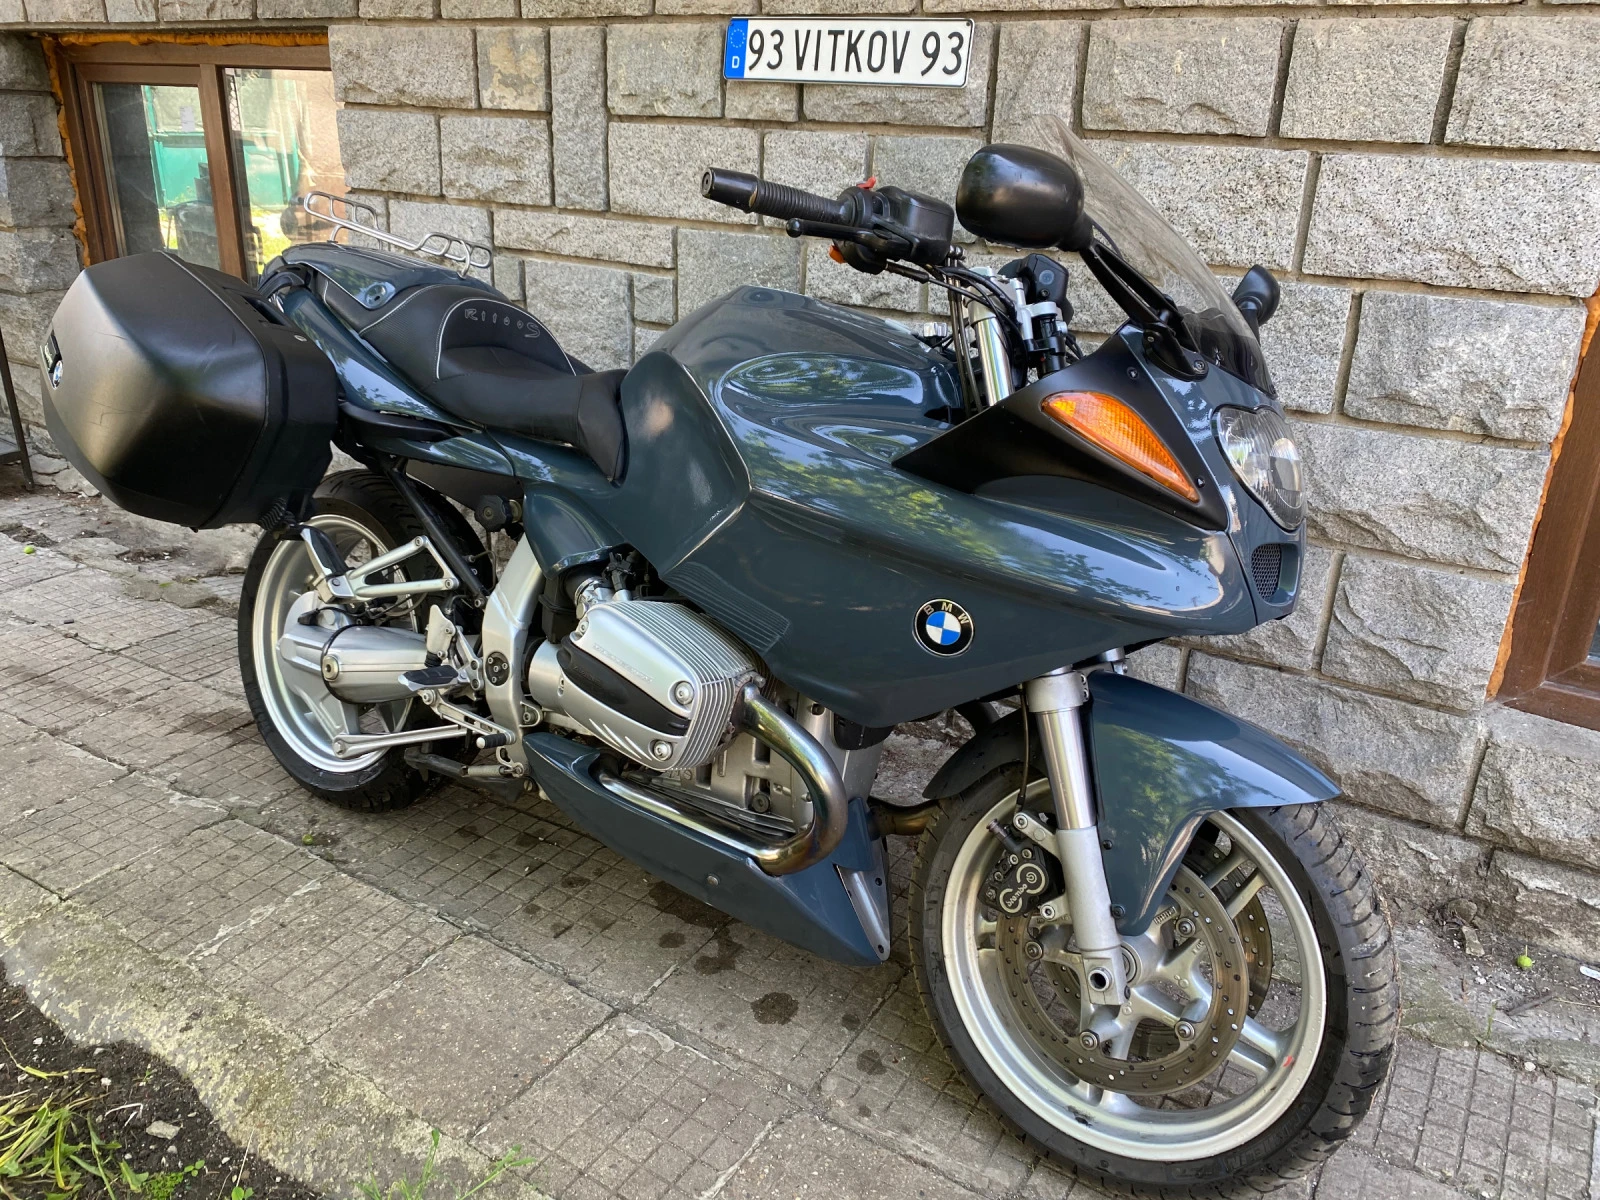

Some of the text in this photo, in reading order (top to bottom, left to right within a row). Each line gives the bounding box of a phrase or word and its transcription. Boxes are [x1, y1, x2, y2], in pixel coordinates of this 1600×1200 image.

[731, 56, 740, 68] D
[748, 29, 964, 77] 93 VITKOV 93
[923, 602, 970, 624] BMW
